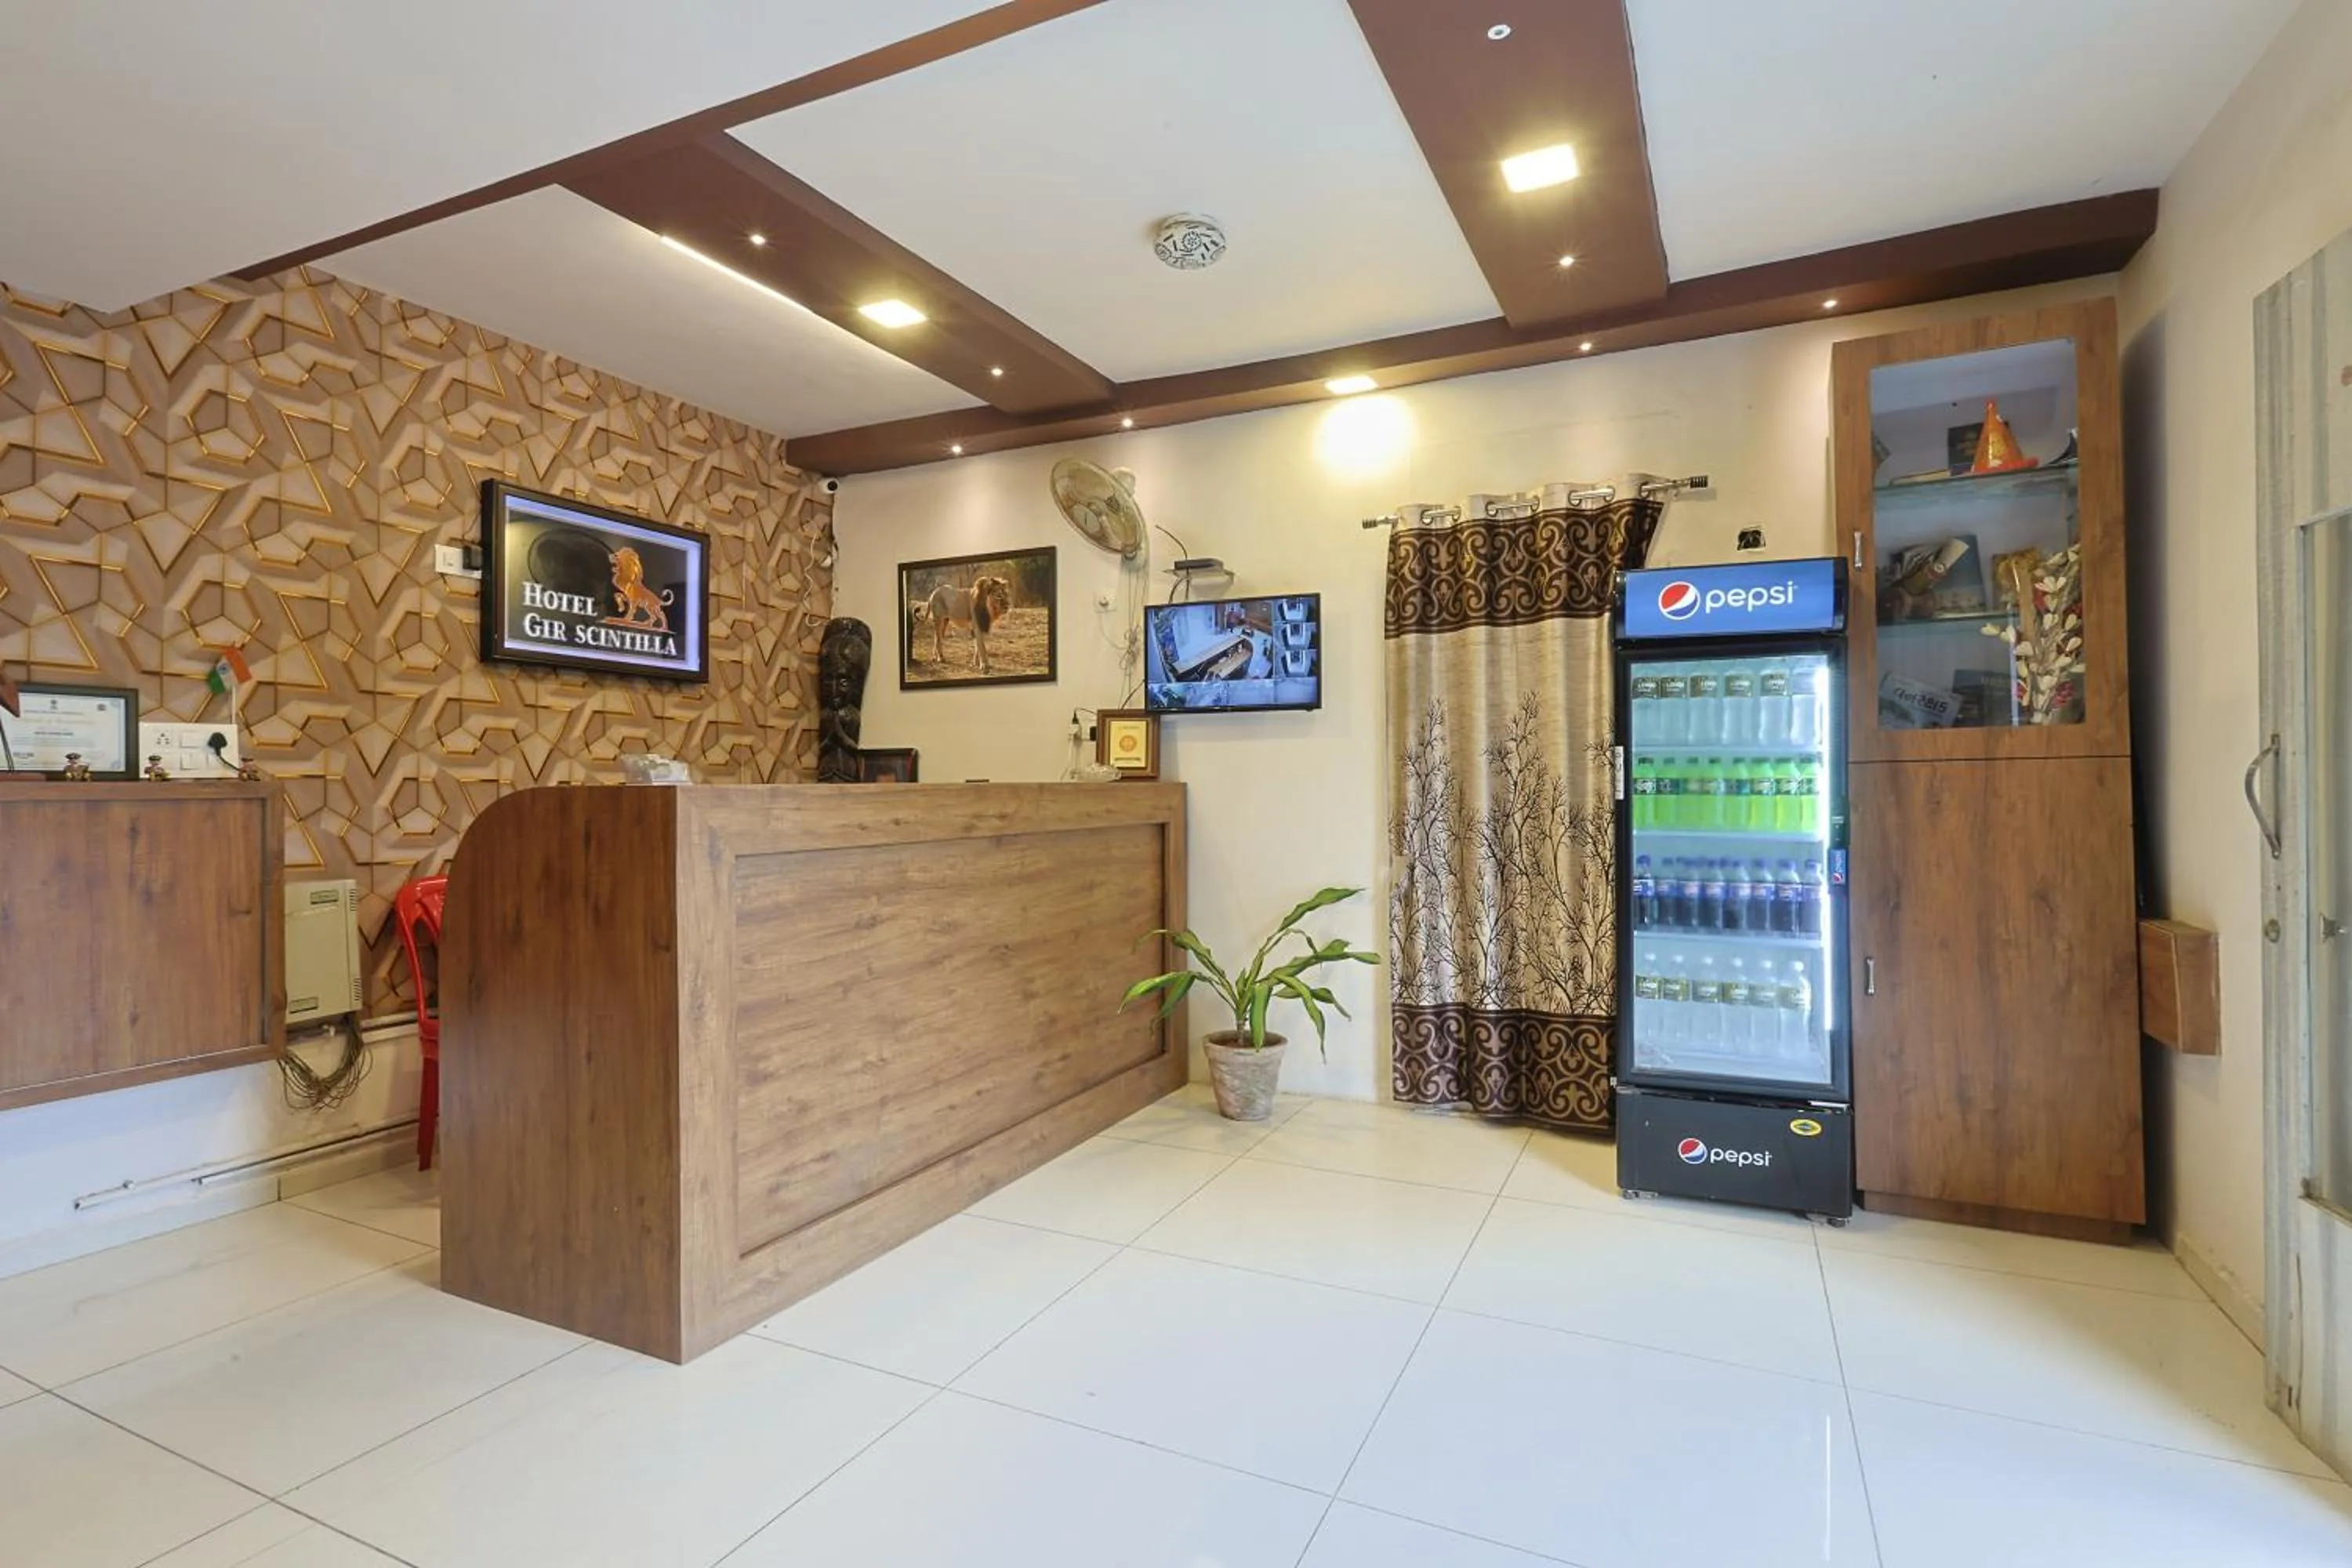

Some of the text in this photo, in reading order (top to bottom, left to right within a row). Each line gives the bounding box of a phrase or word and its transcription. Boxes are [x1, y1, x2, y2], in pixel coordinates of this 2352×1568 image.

[522, 582, 598, 616] HOTEL
[1705, 581, 1795, 614] pepsi
[523, 612, 678, 656] GIR SCINTILLA
[1710, 1147, 1770, 1167] pepsi
